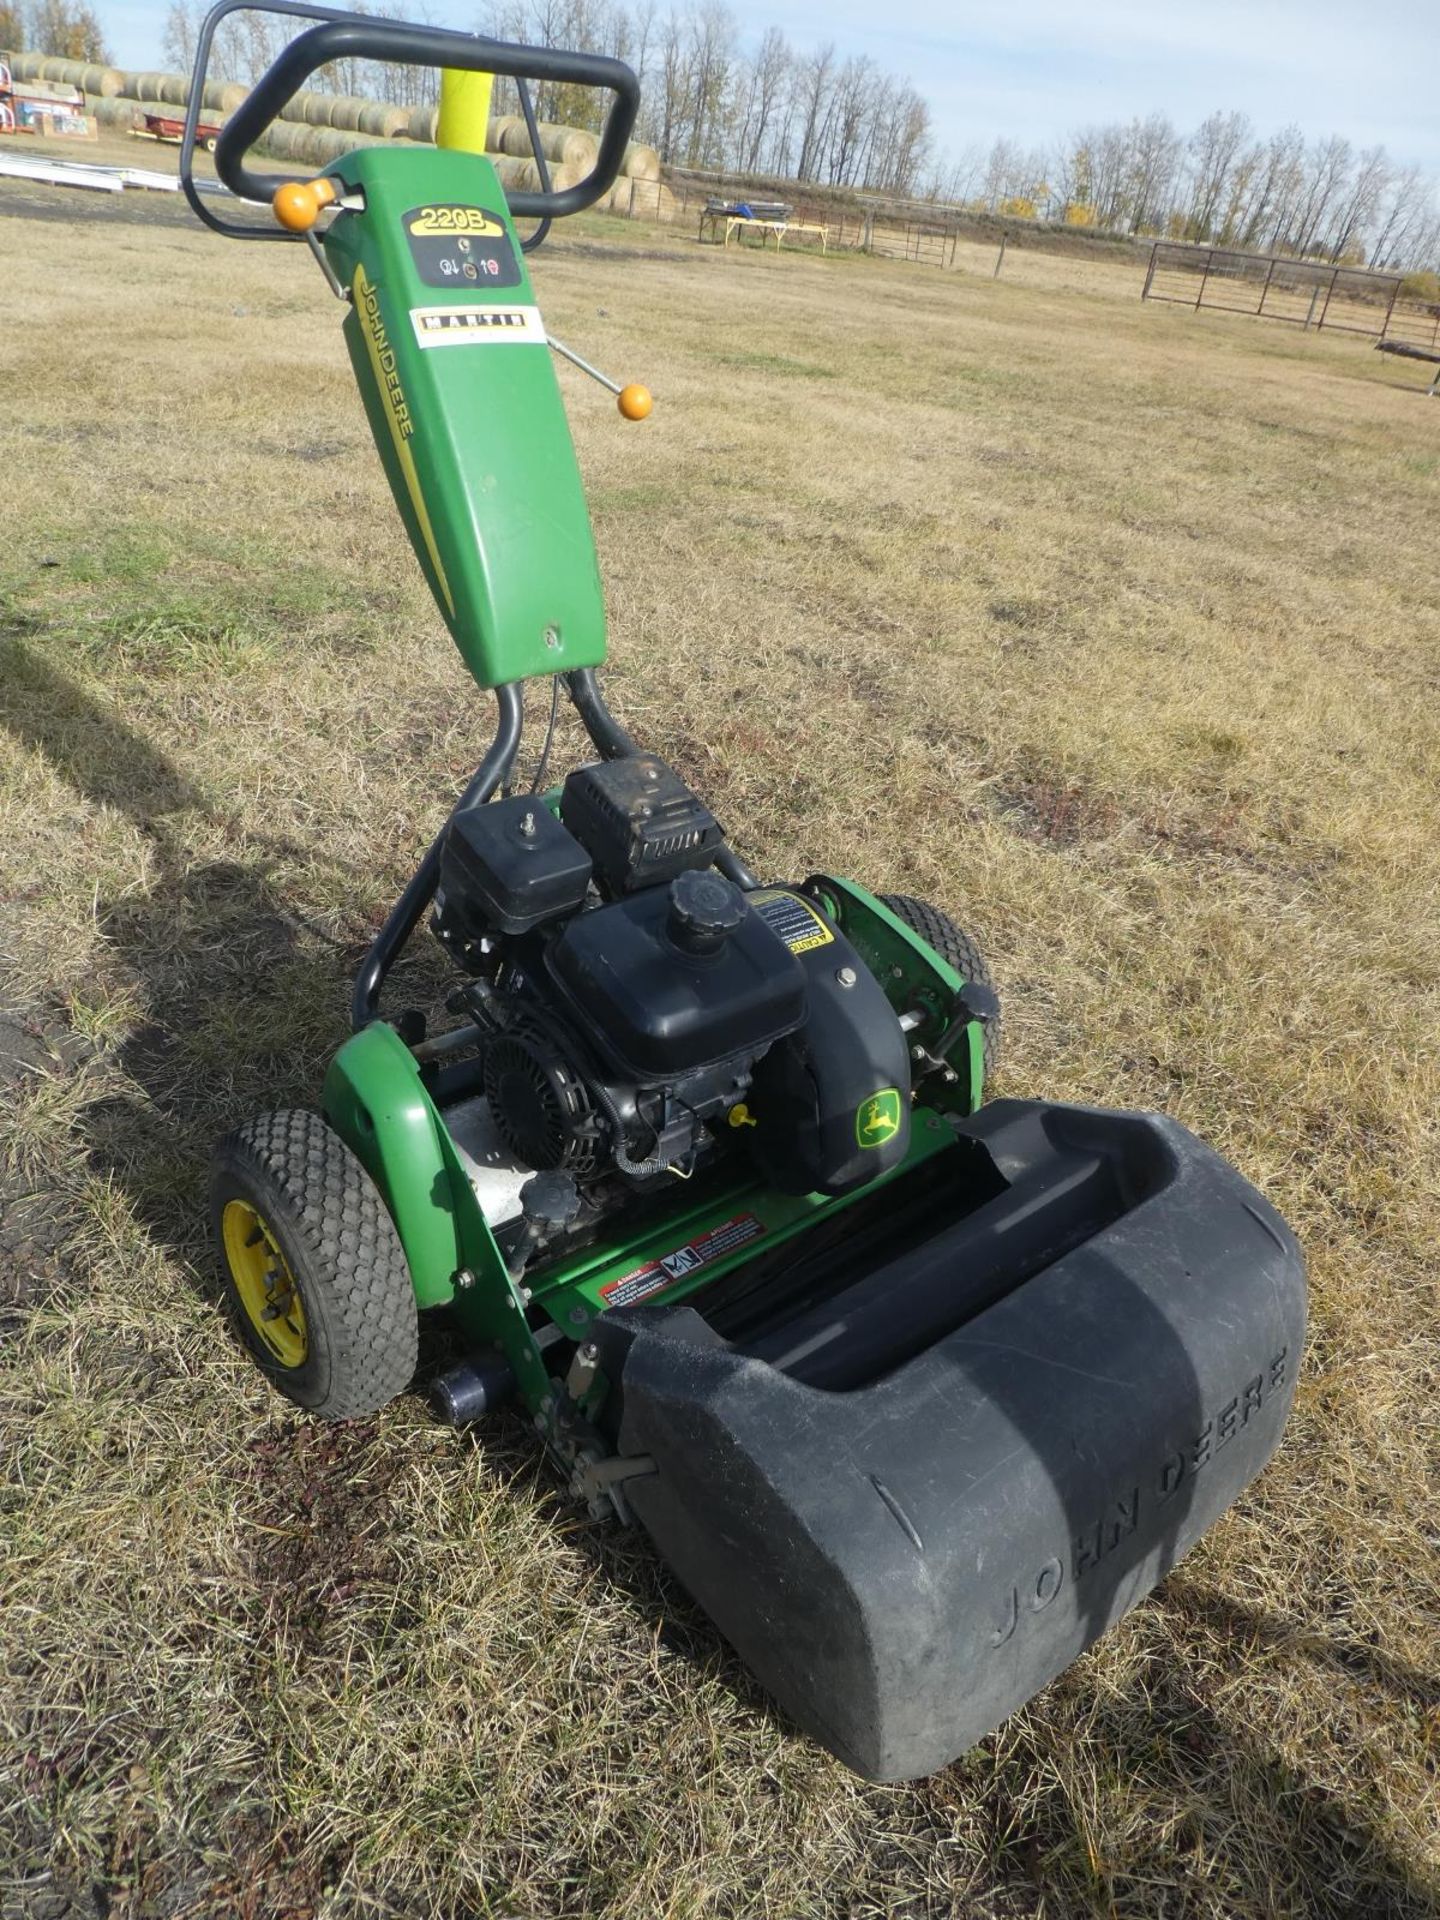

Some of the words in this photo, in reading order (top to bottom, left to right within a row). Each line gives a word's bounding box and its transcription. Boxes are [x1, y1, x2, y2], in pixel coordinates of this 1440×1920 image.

[420, 208, 487, 230] 220B
[424, 314, 526, 330] MARTIN
[361, 282, 389, 353] JOHN
[379, 349, 414, 440] DEERE
[790, 937, 819, 952] CAUTIO
[990, 1487, 1139, 1649] JOHN
[1155, 1346, 1288, 1502] DEERE
